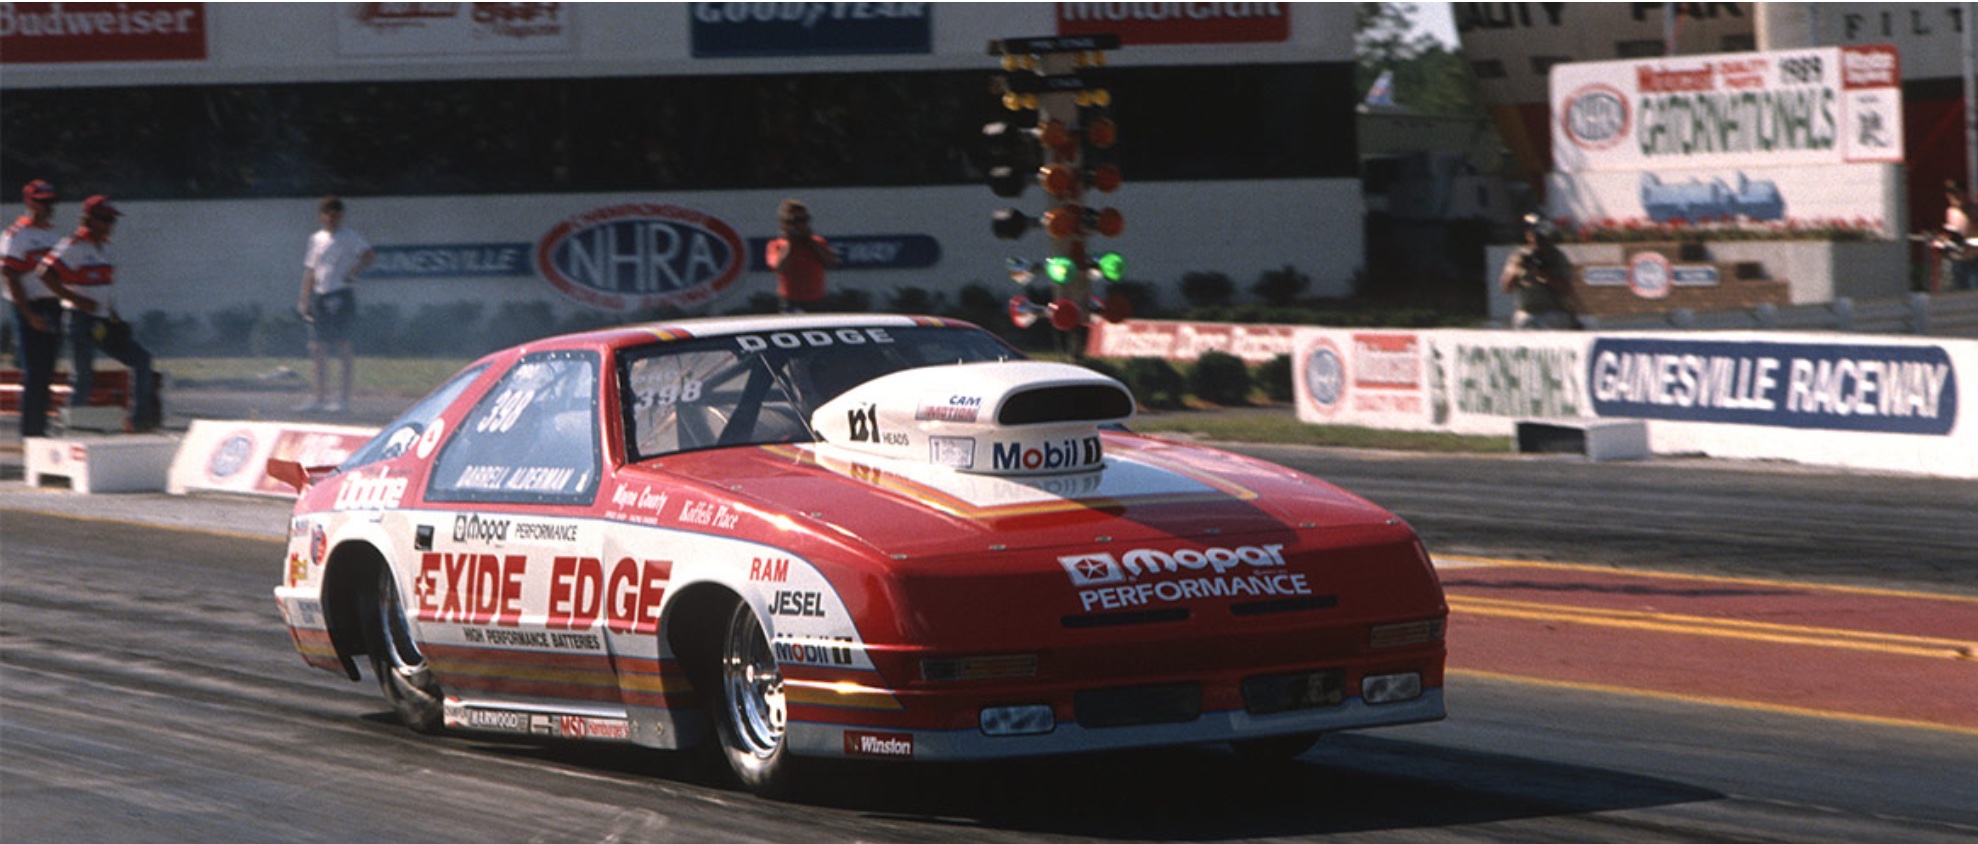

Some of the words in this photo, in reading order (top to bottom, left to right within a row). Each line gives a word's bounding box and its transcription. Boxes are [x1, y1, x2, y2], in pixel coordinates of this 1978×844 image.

[0, 2, 194, 36] Budweiser
[567, 221, 720, 294] NHRA
[734, 328, 896, 352] DODGE
[634, 380, 703, 411] 398
[949, 394, 982, 406] CAM
[1593, 350, 1779, 412] GAINESVILLE
[1786, 357, 1949, 419] RACEWAY
[476, 389, 535, 434] 398
[882, 431, 910, 447] HEADS
[992, 438, 1078, 470] Mobil
[333, 465, 408, 515] Dodge
[611, 482, 638, 511] Wayne
[637, 484, 669, 516] County
[514, 522, 579, 542] PERFORMANCE
[749, 557, 790, 583] RAM
[414, 552, 528, 628] EXIDE
[545, 555, 674, 635] EDGE
[768, 590, 826, 617] JESEL
[1078, 573, 1313, 612] PERFORMANCE
[463, 626, 485, 643] HIGH
[486, 628, 550, 648] PERFORMANCE
[551, 632, 601, 650] BATTERIES
[560, 714, 587, 739] MSD
[861, 735, 911, 755] Winston
